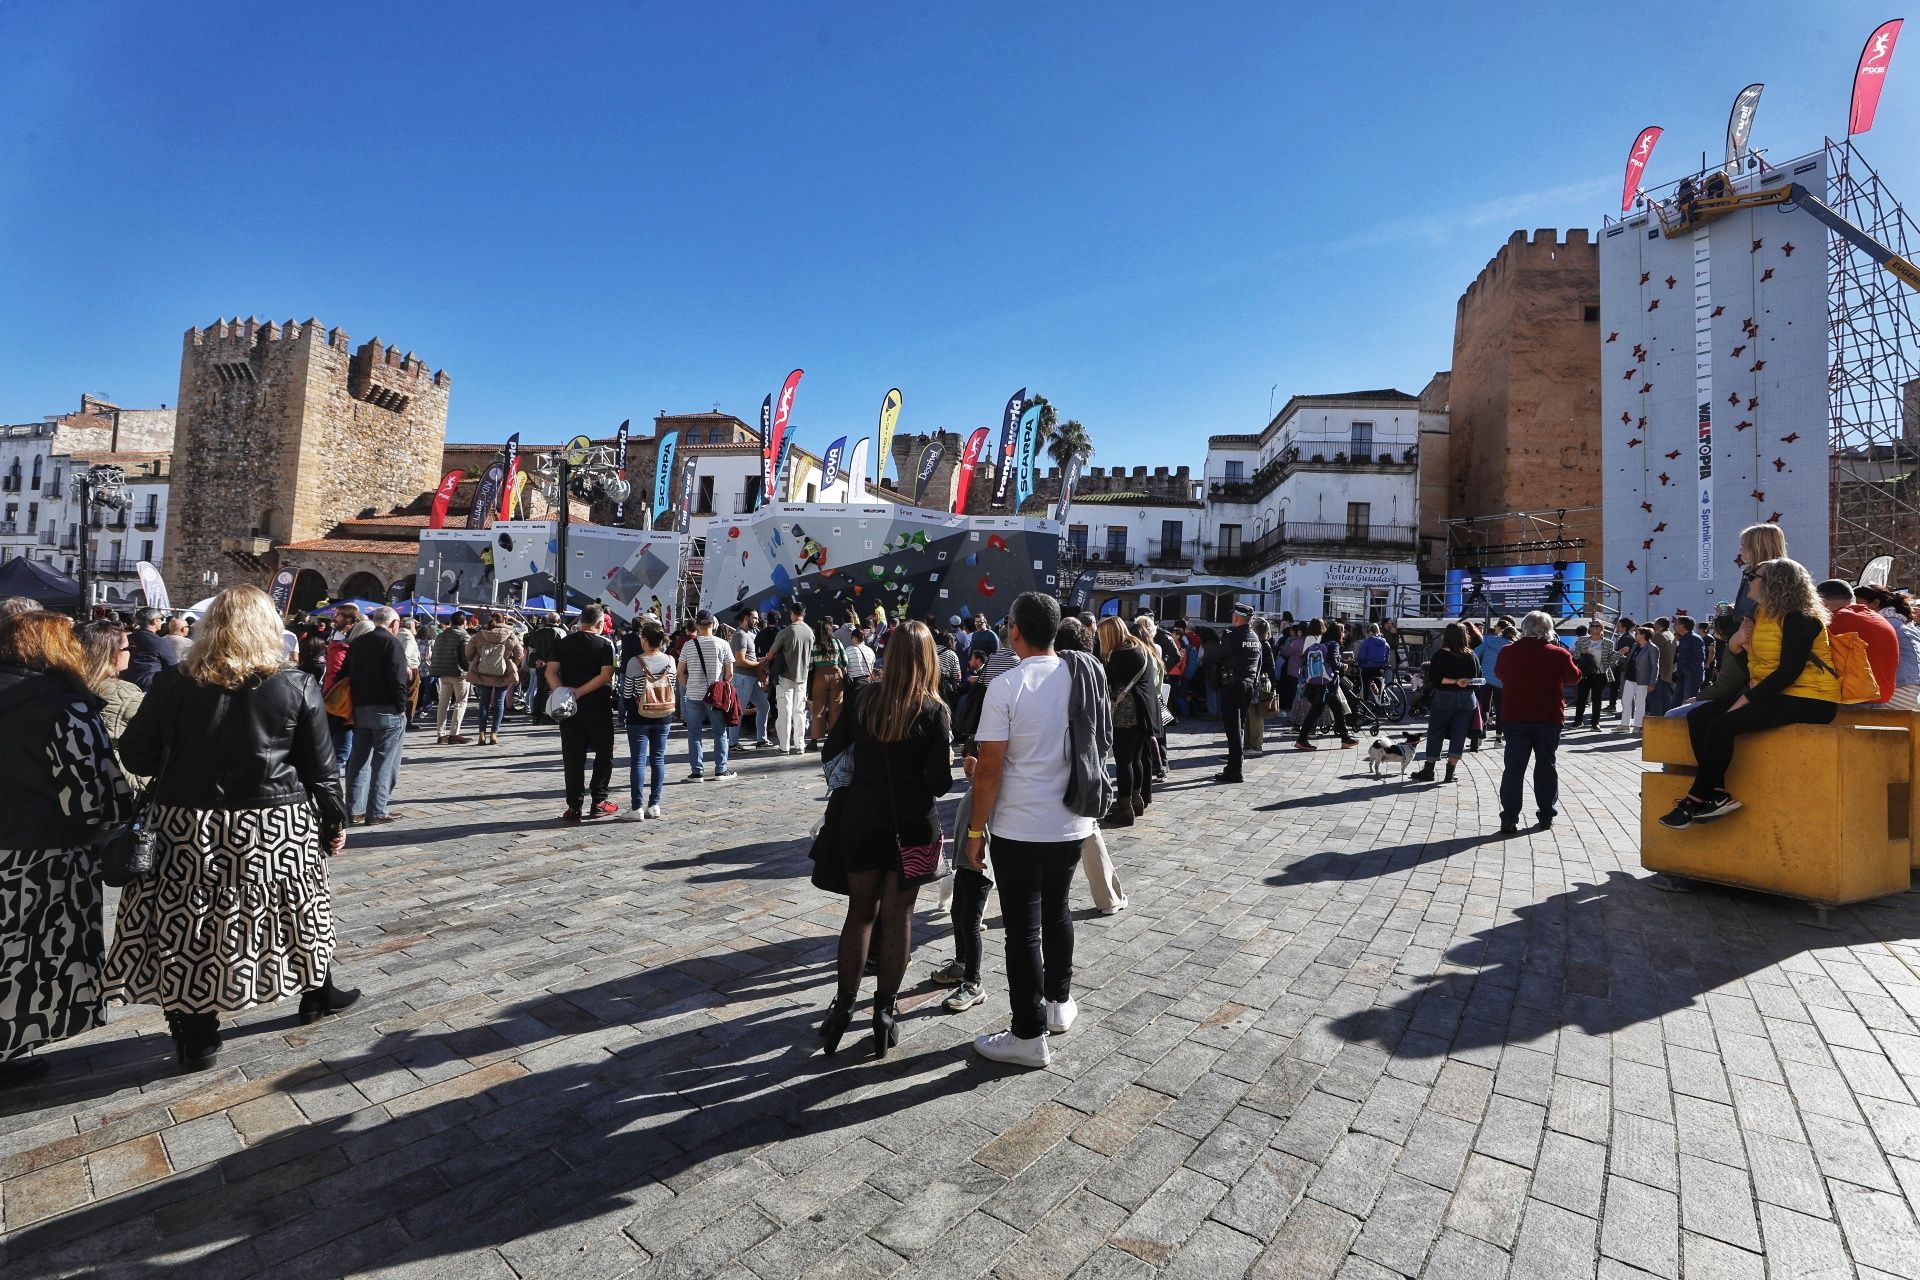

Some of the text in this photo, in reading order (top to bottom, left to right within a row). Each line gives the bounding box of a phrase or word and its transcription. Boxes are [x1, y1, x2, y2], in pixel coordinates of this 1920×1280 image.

[825, 447, 839, 485] GOYA
[1020, 418, 1034, 493] SCARPA
[1697, 401, 1712, 480] WALLTOPIA
[658, 442, 672, 507] SCARPA
[1325, 572, 1391, 582] Visitas Guiadas
[1329, 563, 1389, 575] i-turismo
